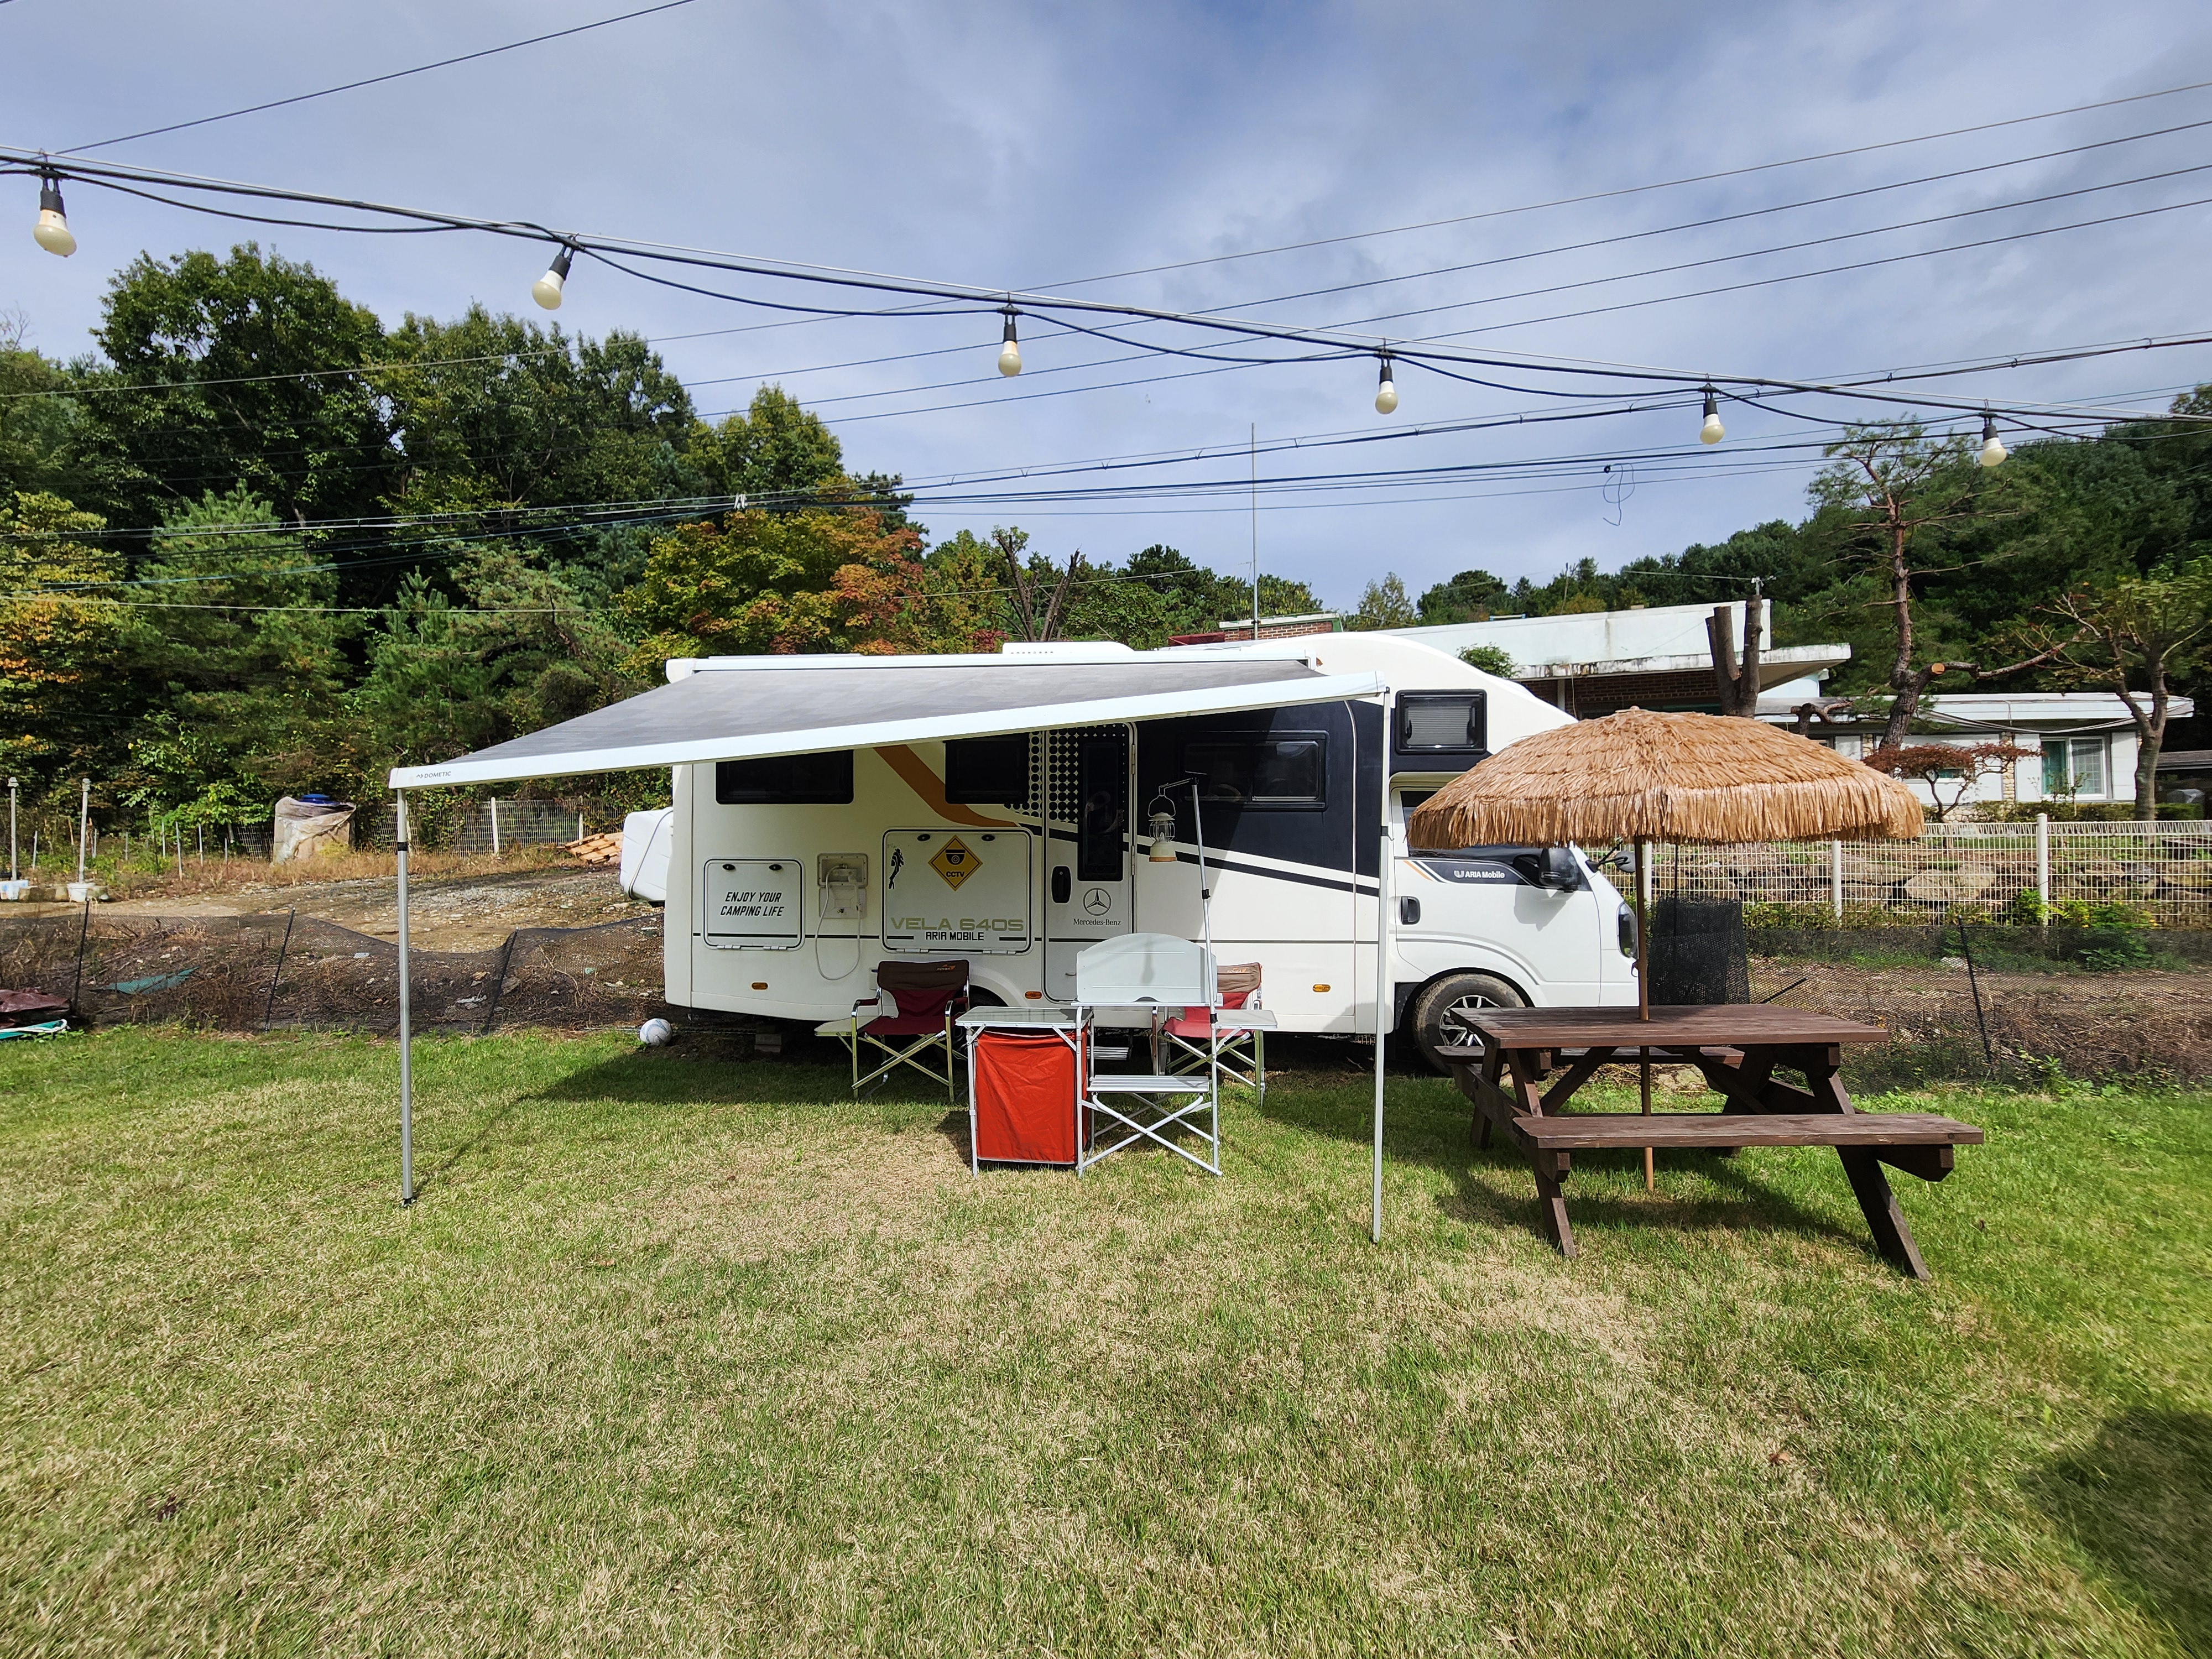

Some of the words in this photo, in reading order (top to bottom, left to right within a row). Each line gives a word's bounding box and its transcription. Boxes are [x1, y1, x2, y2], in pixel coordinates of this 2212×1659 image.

[725, 891, 756, 902] ENJOY
[759, 891, 782, 902] YOUR
[721, 906, 761, 916] CAMPING
[763, 906, 784, 916] LIFE
[890, 917, 952, 930] VELA
[959, 918, 1024, 931] 640S
[926, 931, 947, 940] ARIA
[950, 932, 984, 940] MOBILE
